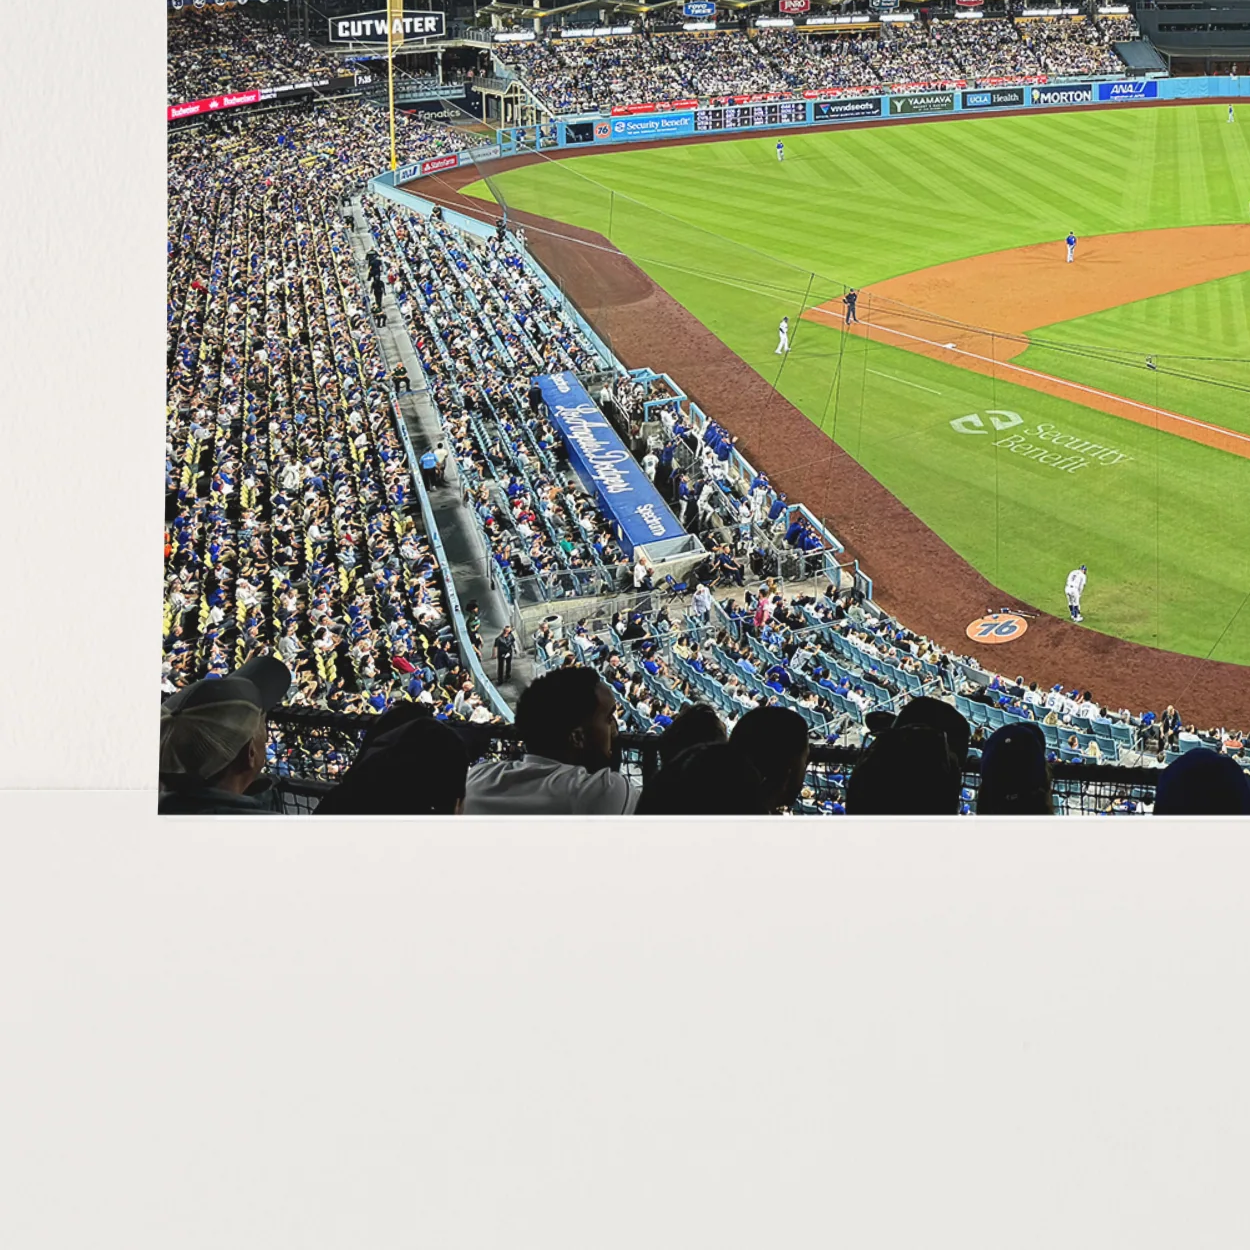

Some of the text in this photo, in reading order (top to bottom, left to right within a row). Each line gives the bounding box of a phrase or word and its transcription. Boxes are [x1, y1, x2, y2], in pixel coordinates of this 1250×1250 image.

[338, 16, 437, 37] CUTWATER
[1110, 84, 1133, 94] ANA
[969, 93, 1019, 104] UCLA Health
[1040, 90, 1092, 104] MORTON
[831, 102, 874, 112] vividseats
[418, 108, 461, 121] Fanatics
[596, 126, 609, 135] 76
[627, 119, 660, 131] Security
[662, 117, 688, 127] Benefit
[1024, 422, 1130, 466] Security
[992, 434, 1090, 474] Benefit
[587, 449, 633, 492] Dodgers
[634, 503, 666, 536] Spectrum
[974, 619, 1019, 638] 76
